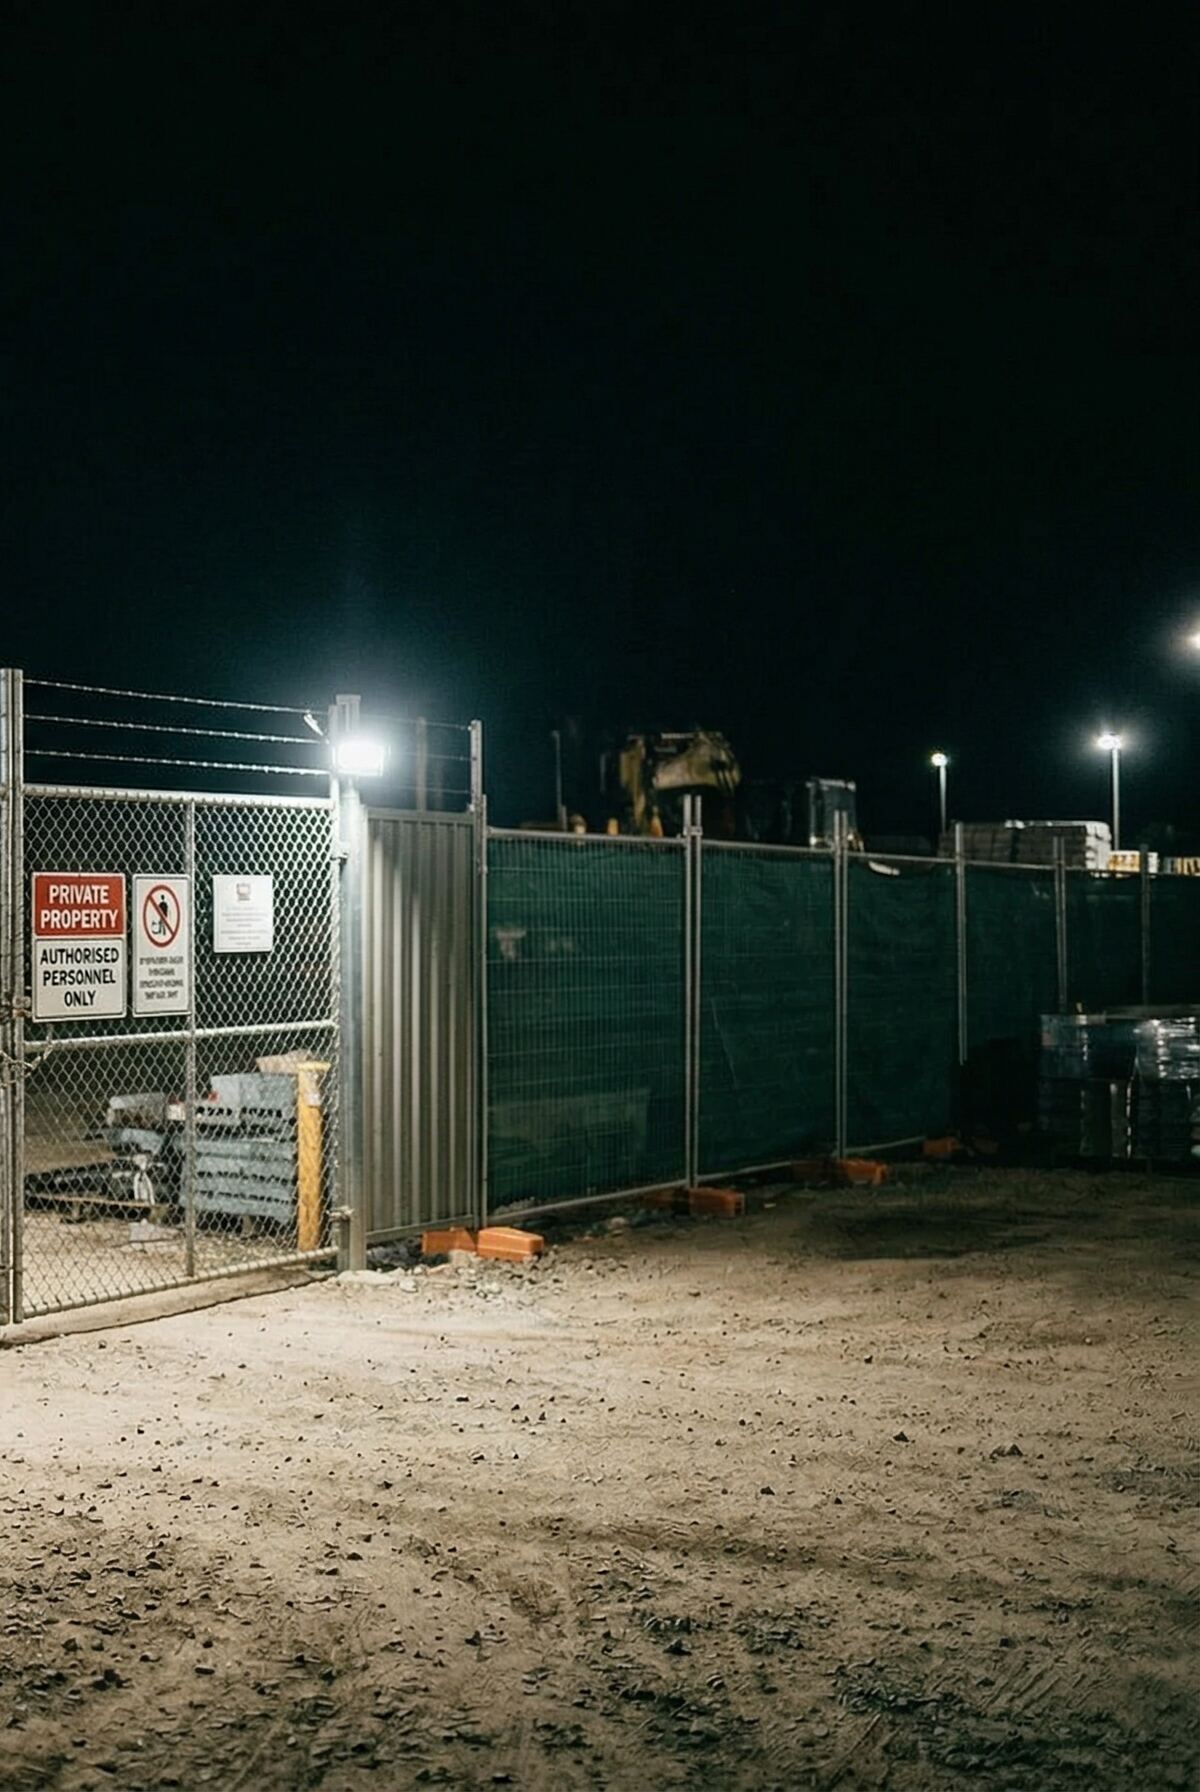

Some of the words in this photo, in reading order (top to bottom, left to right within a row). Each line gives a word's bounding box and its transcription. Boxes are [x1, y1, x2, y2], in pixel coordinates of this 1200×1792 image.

[48, 884, 110, 905] PRIVATE
[40, 908, 119, 930] PROPERTY
[40, 947, 119, 966] AUTHORISED
[43, 968, 116, 987] PERSONNEL
[64, 990, 96, 1007] ONLY
